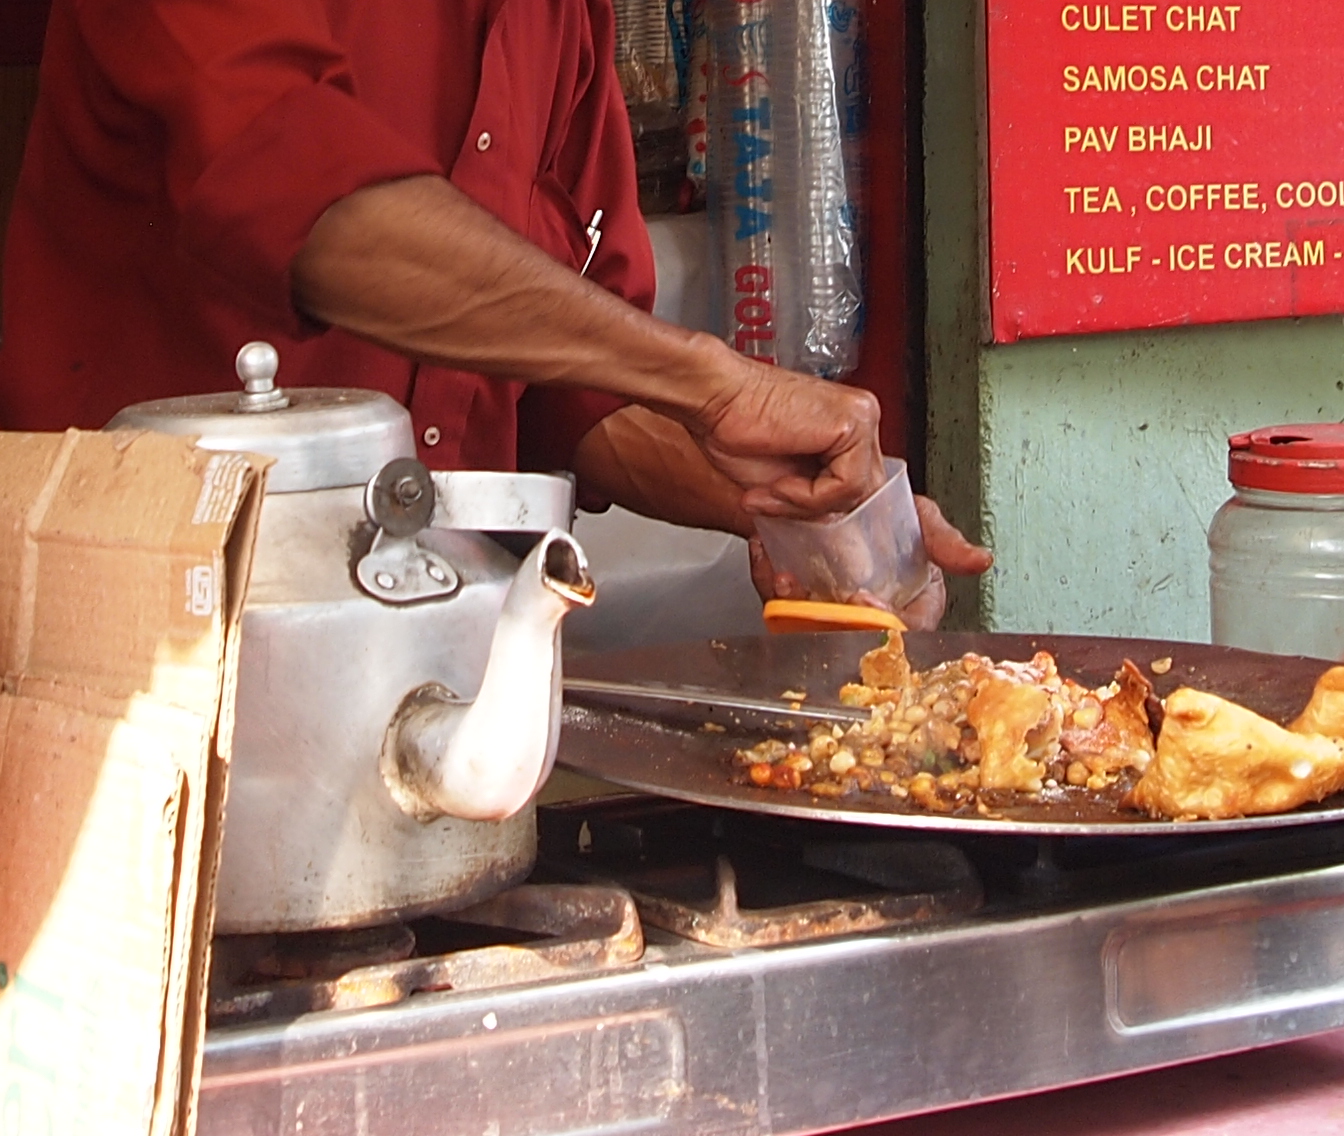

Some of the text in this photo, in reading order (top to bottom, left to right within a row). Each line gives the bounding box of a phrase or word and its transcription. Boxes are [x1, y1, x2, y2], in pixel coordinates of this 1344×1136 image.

[1061, 4, 1241, 32] CULET CHAT
[1063, 64, 1271, 92] SAMOSA CHAT
[1064, 125, 1212, 153] PAV BHAJI
[732, 96, 773, 242] TAJA
[1063, 186, 1123, 214] TEA
[1145, 183, 1267, 214] COFFEE,
[1066, 246, 1142, 275] KULF
[1169, 243, 1215, 271] ICE
[1224, 240, 1325, 269] CREAM
